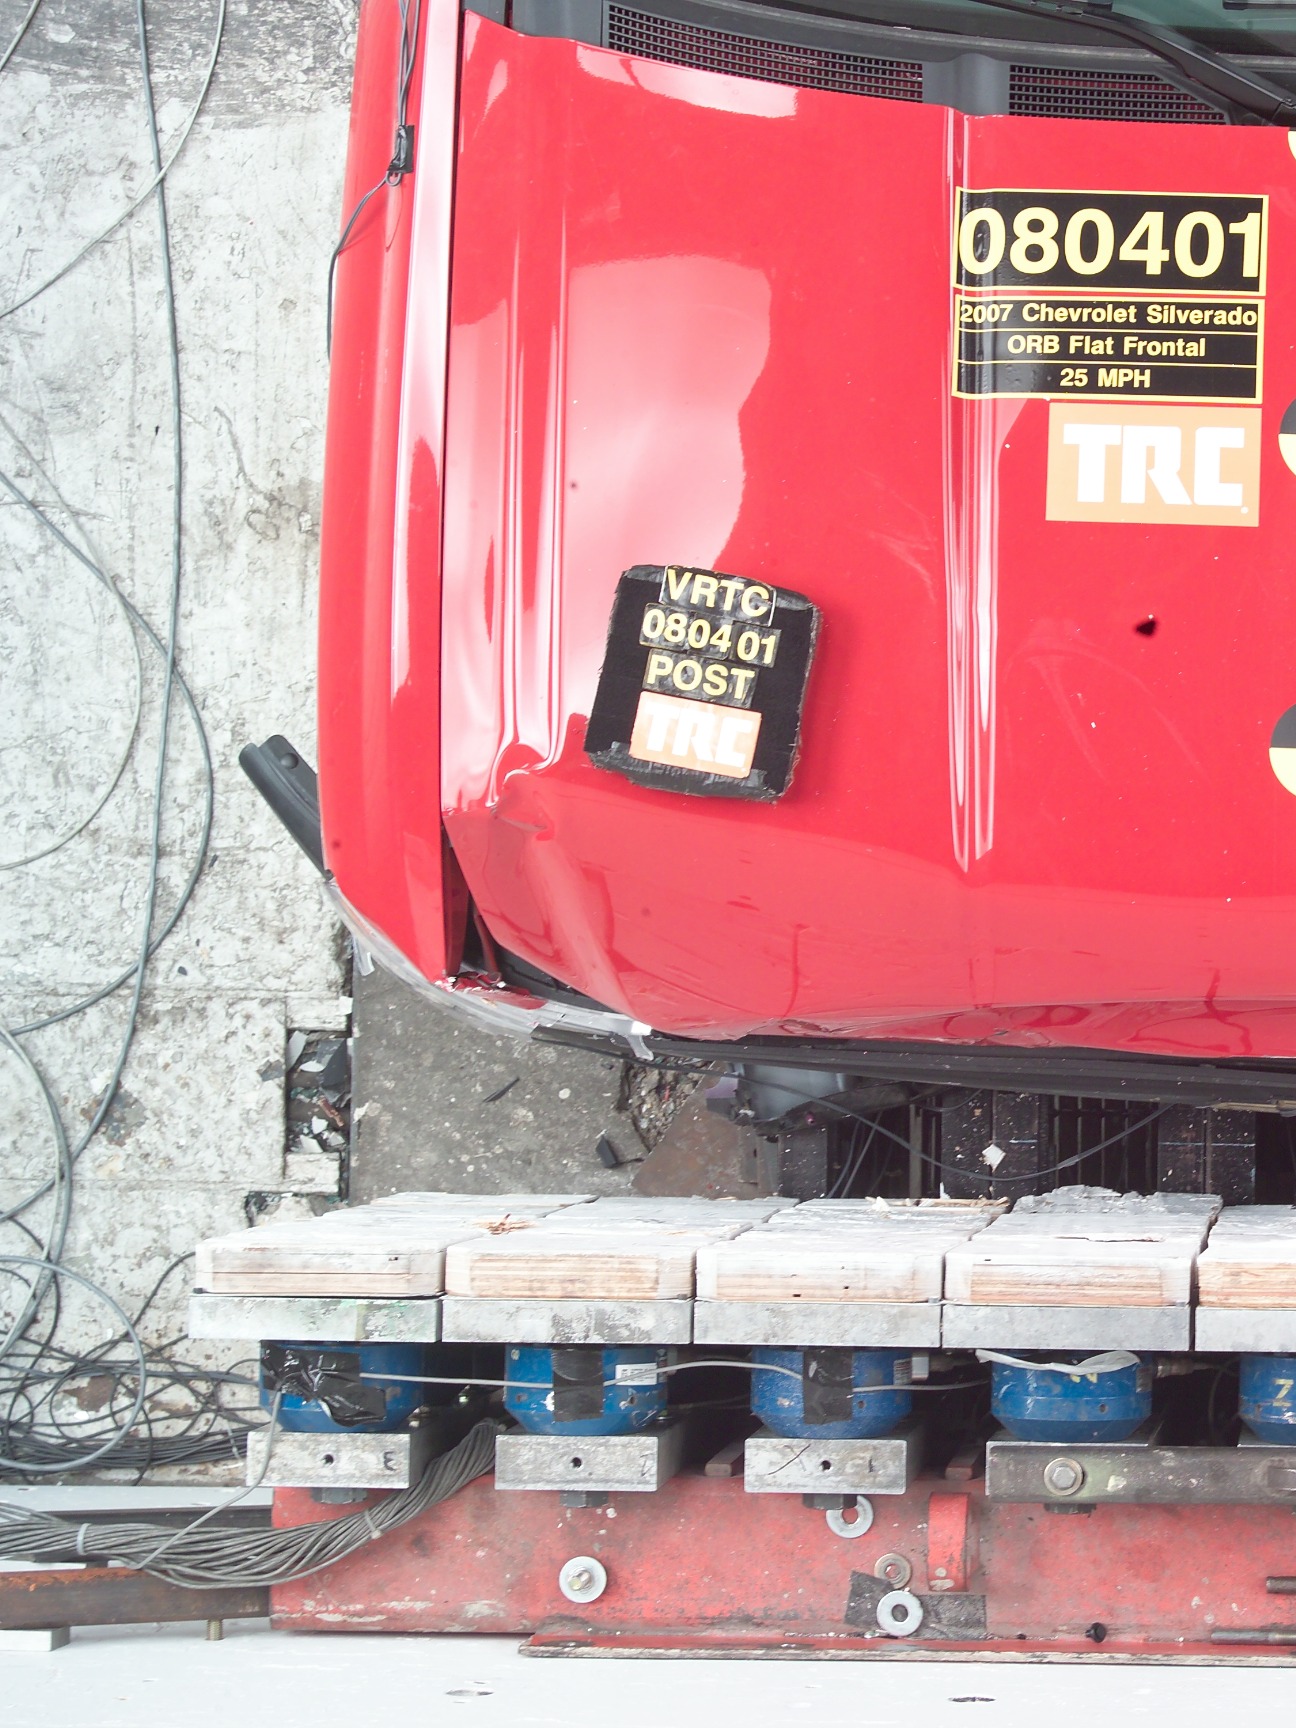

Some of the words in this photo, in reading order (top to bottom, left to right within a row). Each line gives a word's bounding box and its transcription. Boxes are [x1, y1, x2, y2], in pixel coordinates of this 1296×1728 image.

[958, 206, 1262, 278] 080401
[959, 304, 1014, 324] 2007
[1021, 302, 1137, 324] Chevrolet
[1146, 304, 1258, 327] Silverado
[1007, 334, 1060, 355] ORB
[1068, 334, 1115, 356] Flat
[1123, 336, 1207, 358] Frontal
[1059, 368, 1089, 388] 25
[1097, 368, 1151, 388] MPH
[1063, 422, 1246, 507] TRC
[666, 568, 770, 618] VRTC
[646, 653, 756, 701] POST
[642, 700, 756, 769] TRC
